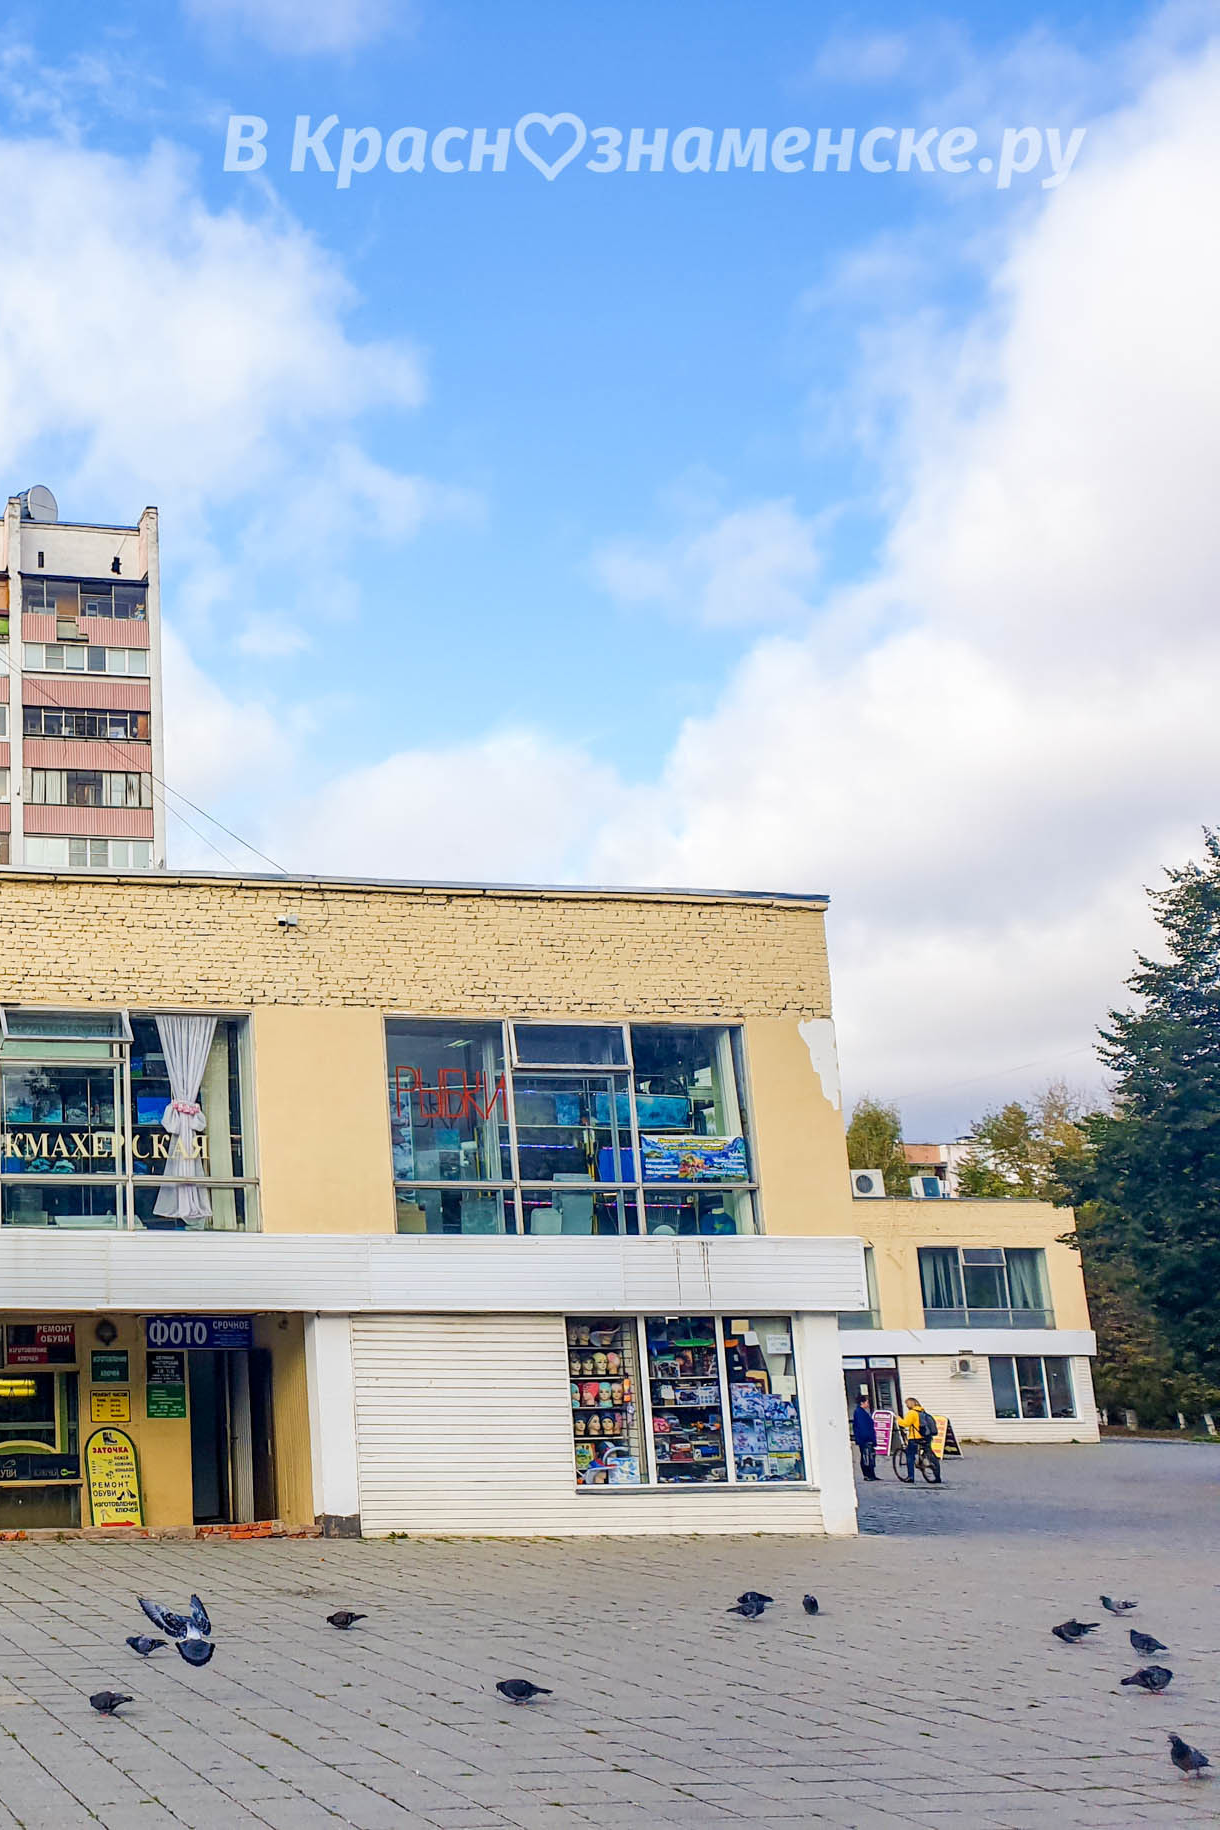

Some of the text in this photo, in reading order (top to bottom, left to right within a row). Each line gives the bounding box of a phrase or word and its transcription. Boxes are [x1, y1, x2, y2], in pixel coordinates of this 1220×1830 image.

[395, 1065, 508, 1121] РЫБКИ
[37, 1324, 73, 1333] РЕМОНТ
[149, 1320, 207, 1345] ФОТО
[213, 1320, 250, 1330] СРОЧНОЕ
[41, 1335, 70, 1343] ОБУВИ
